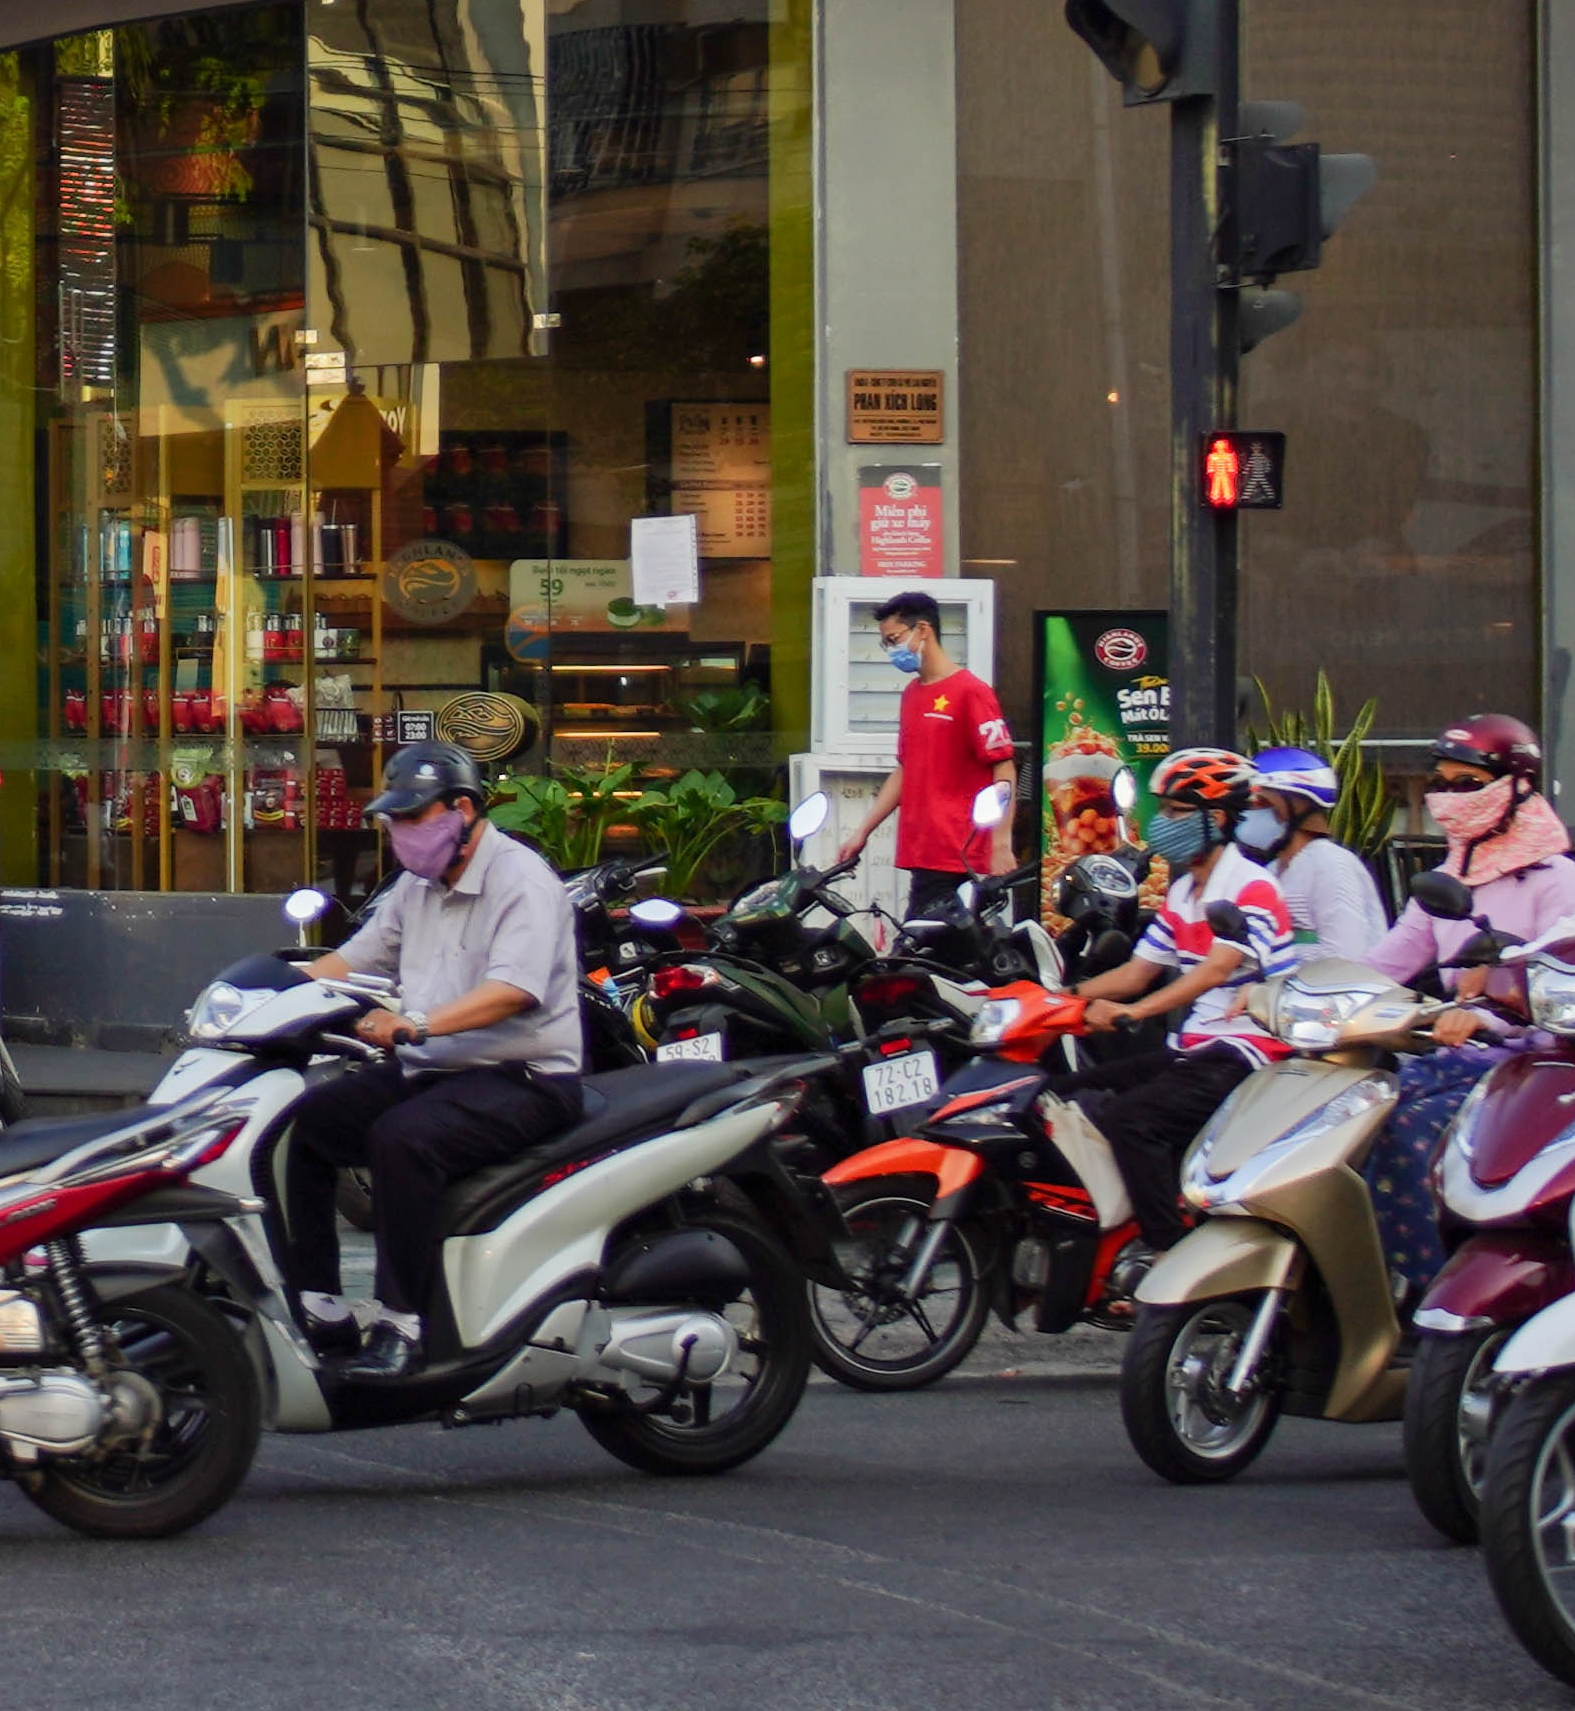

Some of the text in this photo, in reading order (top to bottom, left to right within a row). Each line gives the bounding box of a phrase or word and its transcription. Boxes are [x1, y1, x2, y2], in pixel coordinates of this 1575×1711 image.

[1117, 689, 1158, 709] Sen
[875, 1058, 923, 1088] 72-C2
[873, 1077, 934, 1108] 182.18
